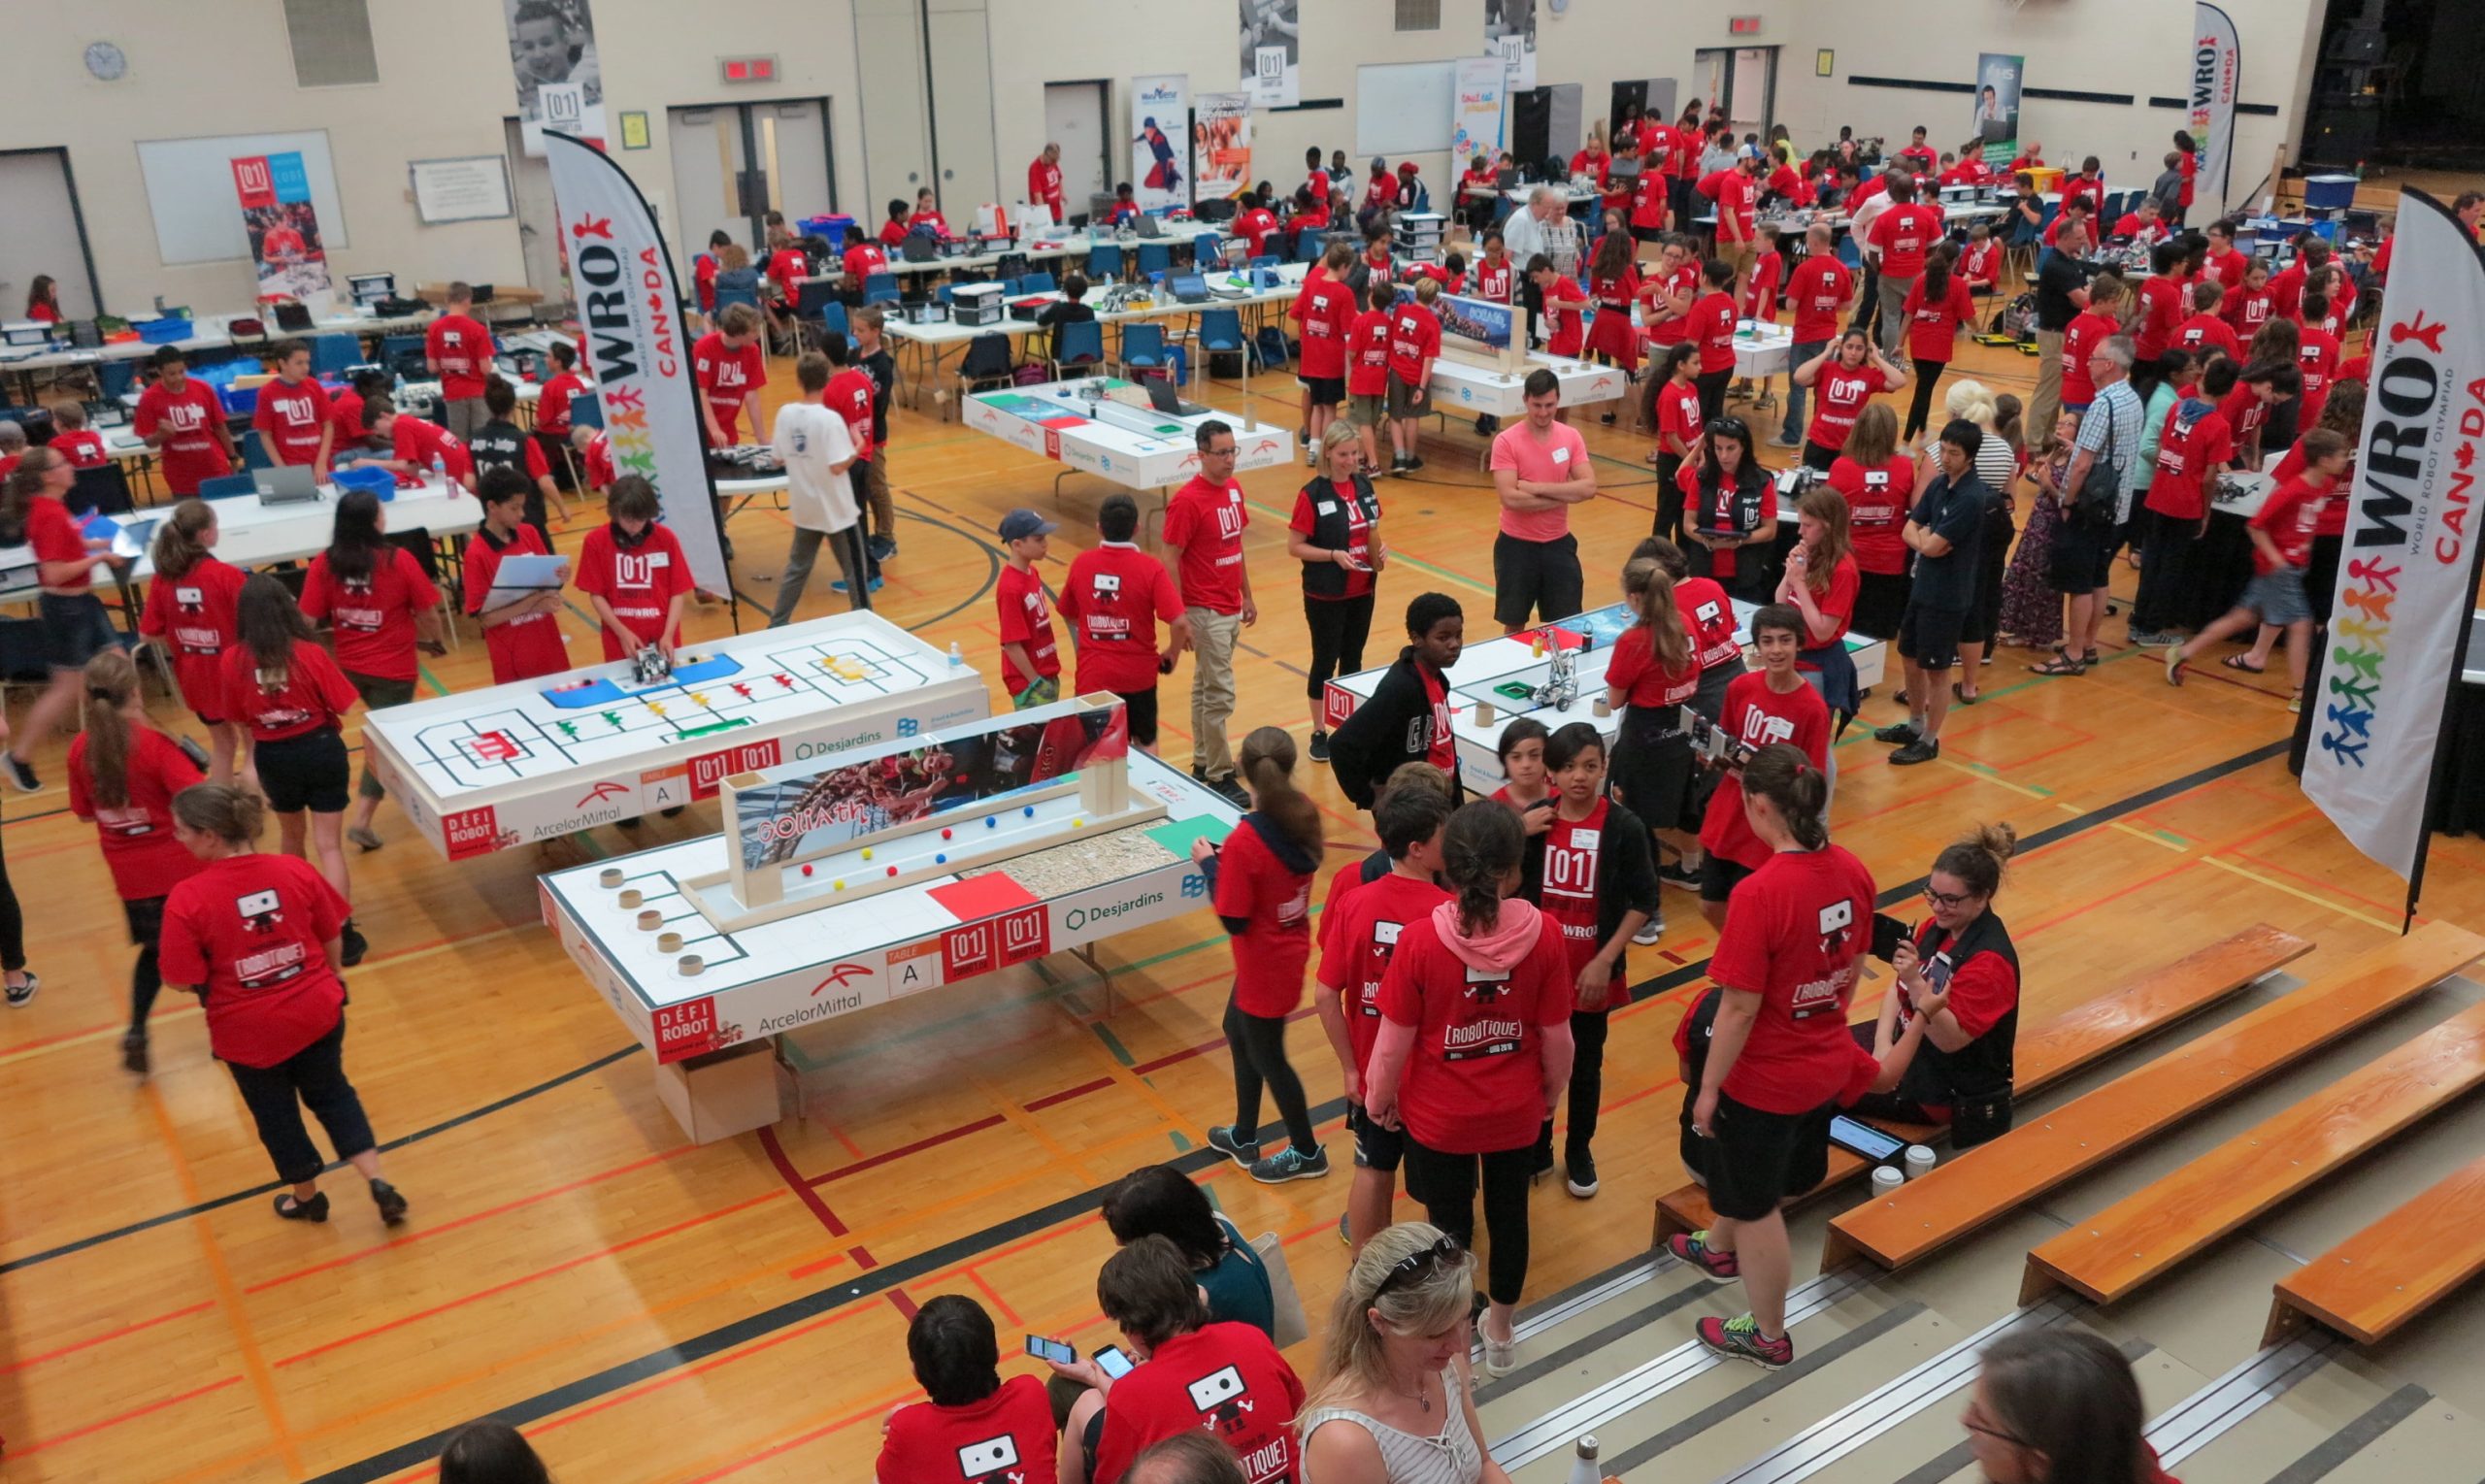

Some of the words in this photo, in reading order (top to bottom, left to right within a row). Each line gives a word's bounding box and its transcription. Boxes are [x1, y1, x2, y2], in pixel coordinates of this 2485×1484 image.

[2193, 49, 2217, 107] WRO
[546, 91, 580, 118] [01]
[237, 161, 269, 189] [01]
[579, 245, 639, 384] WRO
[2353, 356, 2437, 547] WRO
[2410, 506, 2428, 555] WORLD
[2422, 450, 2438, 499] ROBOT
[2433, 368, 2454, 444] OLYMPIAD
[615, 552, 652, 584] [01]
[1328, 684, 1349, 718] [01]
[742, 742, 775, 773] [01]
[816, 730, 881, 756] Desjardins
[694, 755, 727, 784] [01]
[656, 786, 670, 803] A
[447, 809, 489, 831] DÉFI
[450, 823, 491, 844] ROBOT
[533, 805, 621, 839] ArcelorMittal
[1543, 844, 1598, 892] [01]
[1090, 892, 1164, 922] Desjardins
[1006, 909, 1042, 946] [01]
[889, 946, 917, 962] TABLE
[950, 926, 987, 963] [01]
[903, 964, 918, 984] A
[659, 1002, 708, 1028] DÉFI
[758, 992, 862, 1034] ArcelorMittal
[662, 1017, 710, 1042] ROBOT
[1240, 1436, 1287, 1479] TiQUE]
